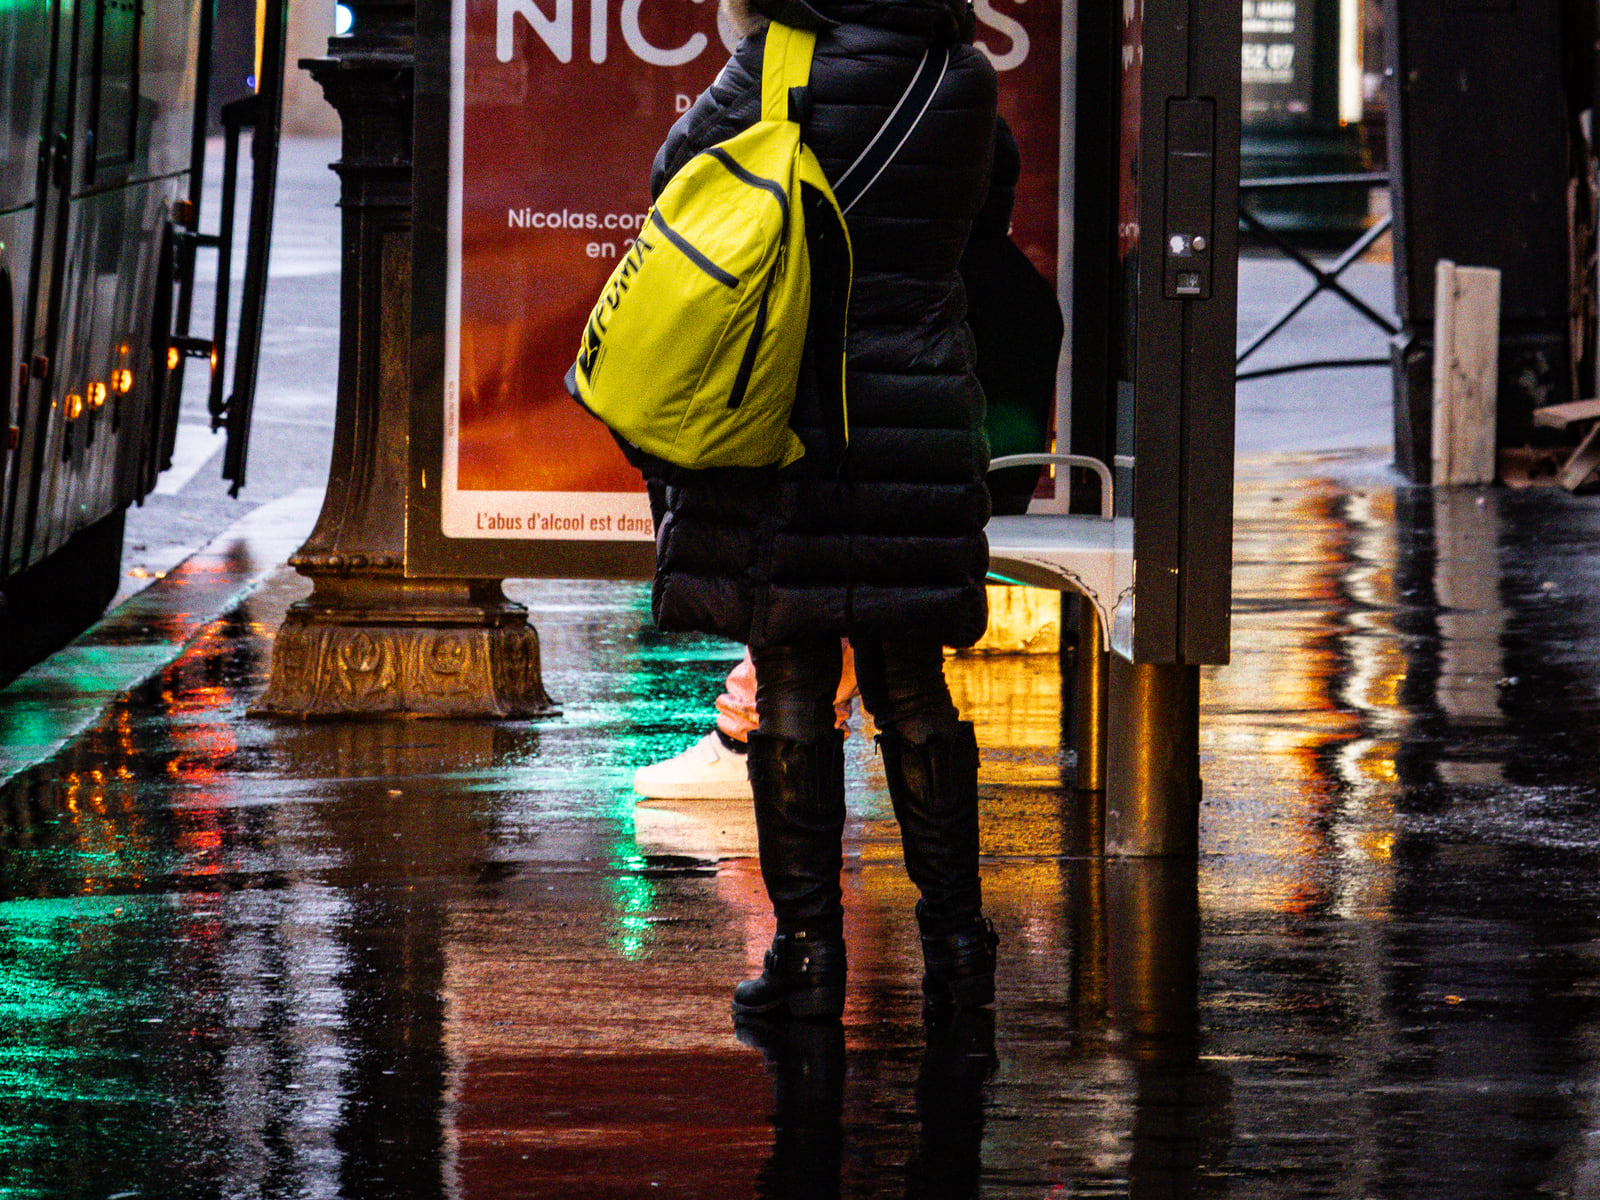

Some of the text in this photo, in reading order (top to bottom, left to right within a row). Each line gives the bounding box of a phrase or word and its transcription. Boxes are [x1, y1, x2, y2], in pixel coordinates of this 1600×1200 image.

[585, 242, 616, 258] en
[476, 511, 522, 530] L'abus
[527, 512, 584, 531] d'alcool
[590, 514, 611, 531] est
